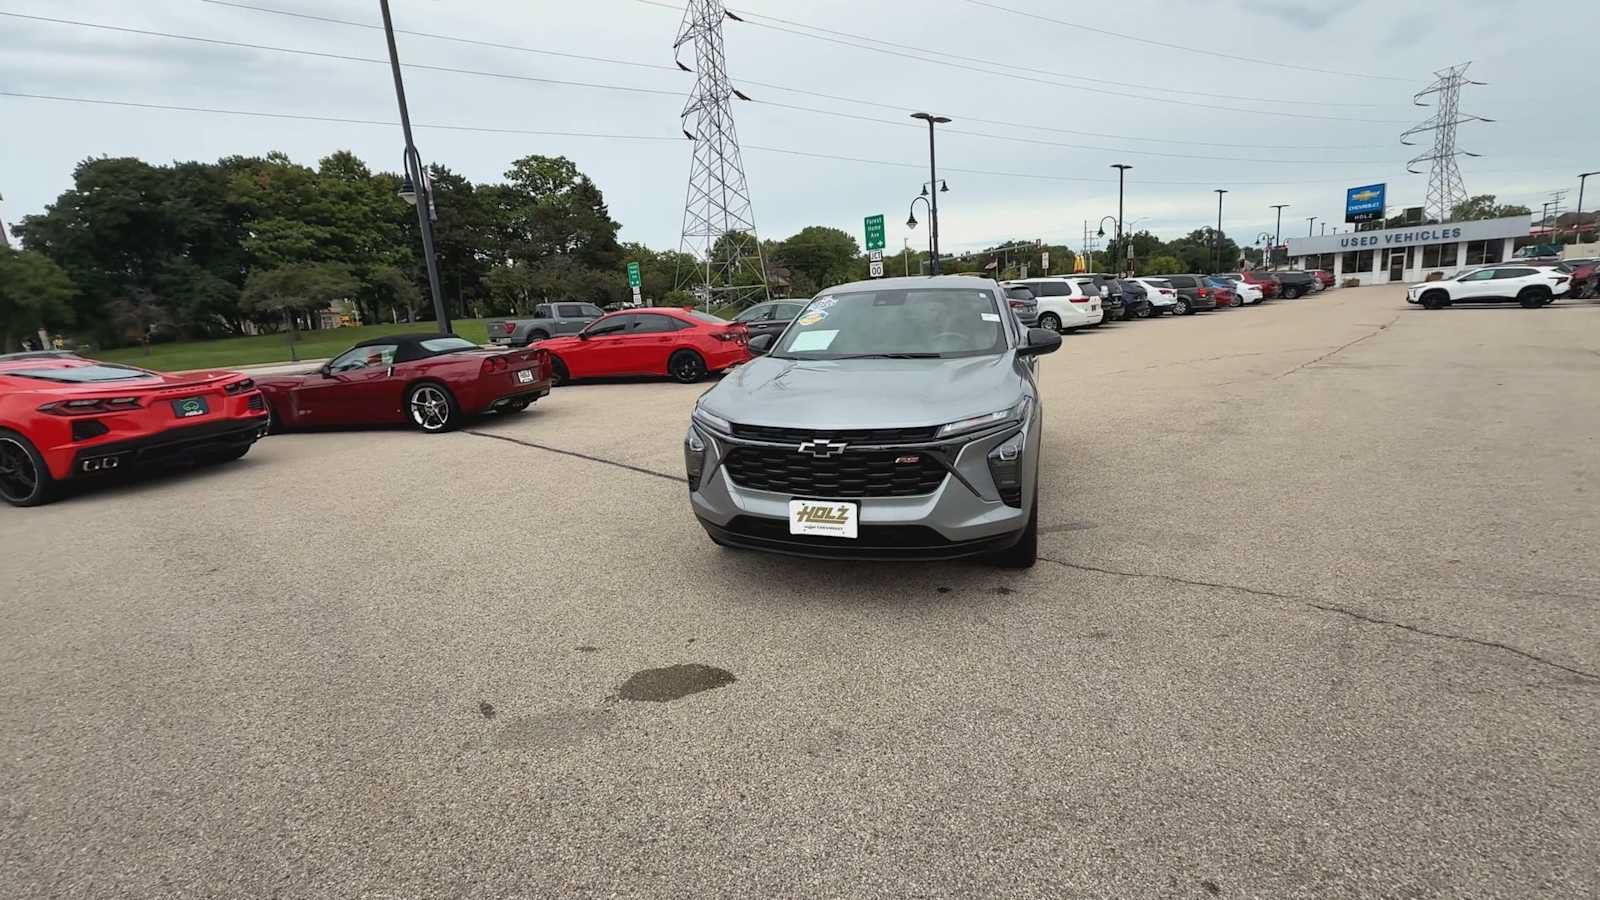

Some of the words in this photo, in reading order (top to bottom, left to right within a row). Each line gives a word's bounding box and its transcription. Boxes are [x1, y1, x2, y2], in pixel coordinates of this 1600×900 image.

[1341, 235, 1378, 248] USED
[1385, 227, 1462, 244] VEHICLES
[796, 505, 850, 525] HOLZ
